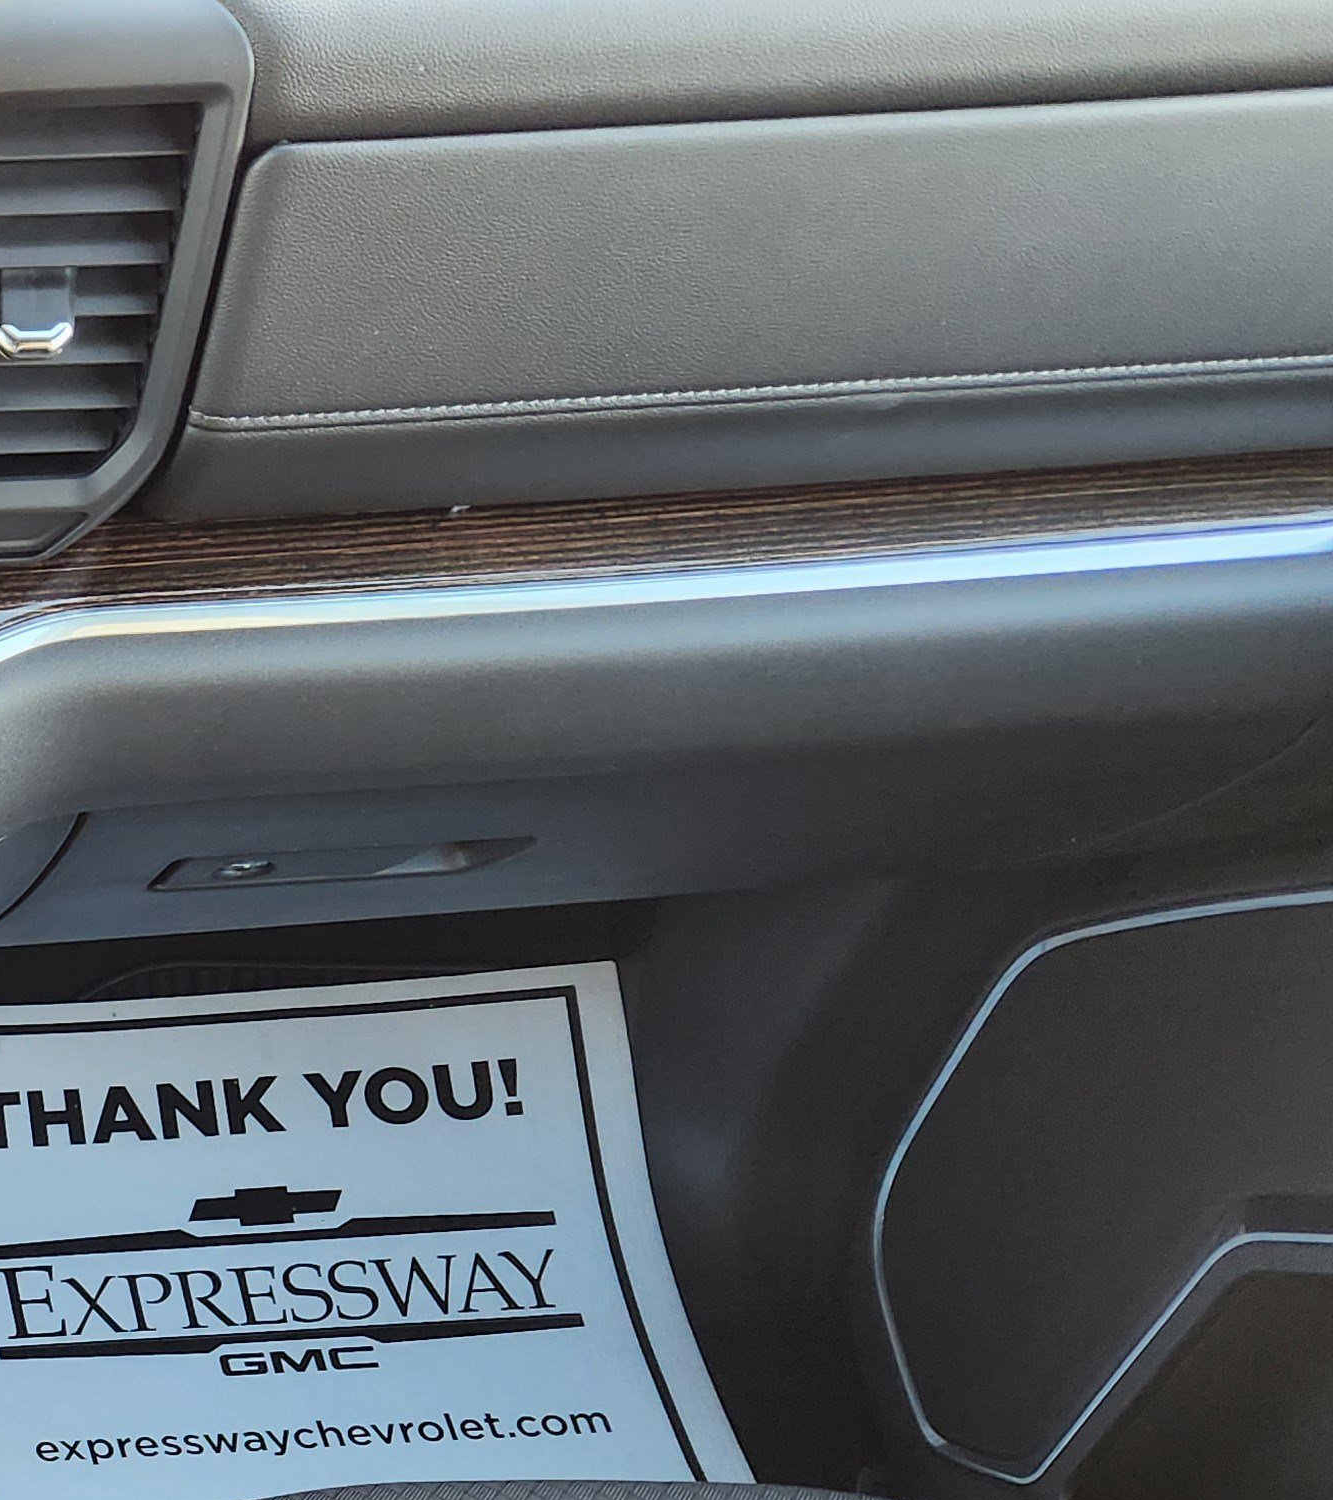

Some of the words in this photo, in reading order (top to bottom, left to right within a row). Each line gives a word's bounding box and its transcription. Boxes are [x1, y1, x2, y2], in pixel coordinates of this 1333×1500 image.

[303, 1057, 525, 1129] YOU!
[219, 1345, 379, 1377] GMC
[35, 1408, 613, 1465] expresswaychevrolet.com
